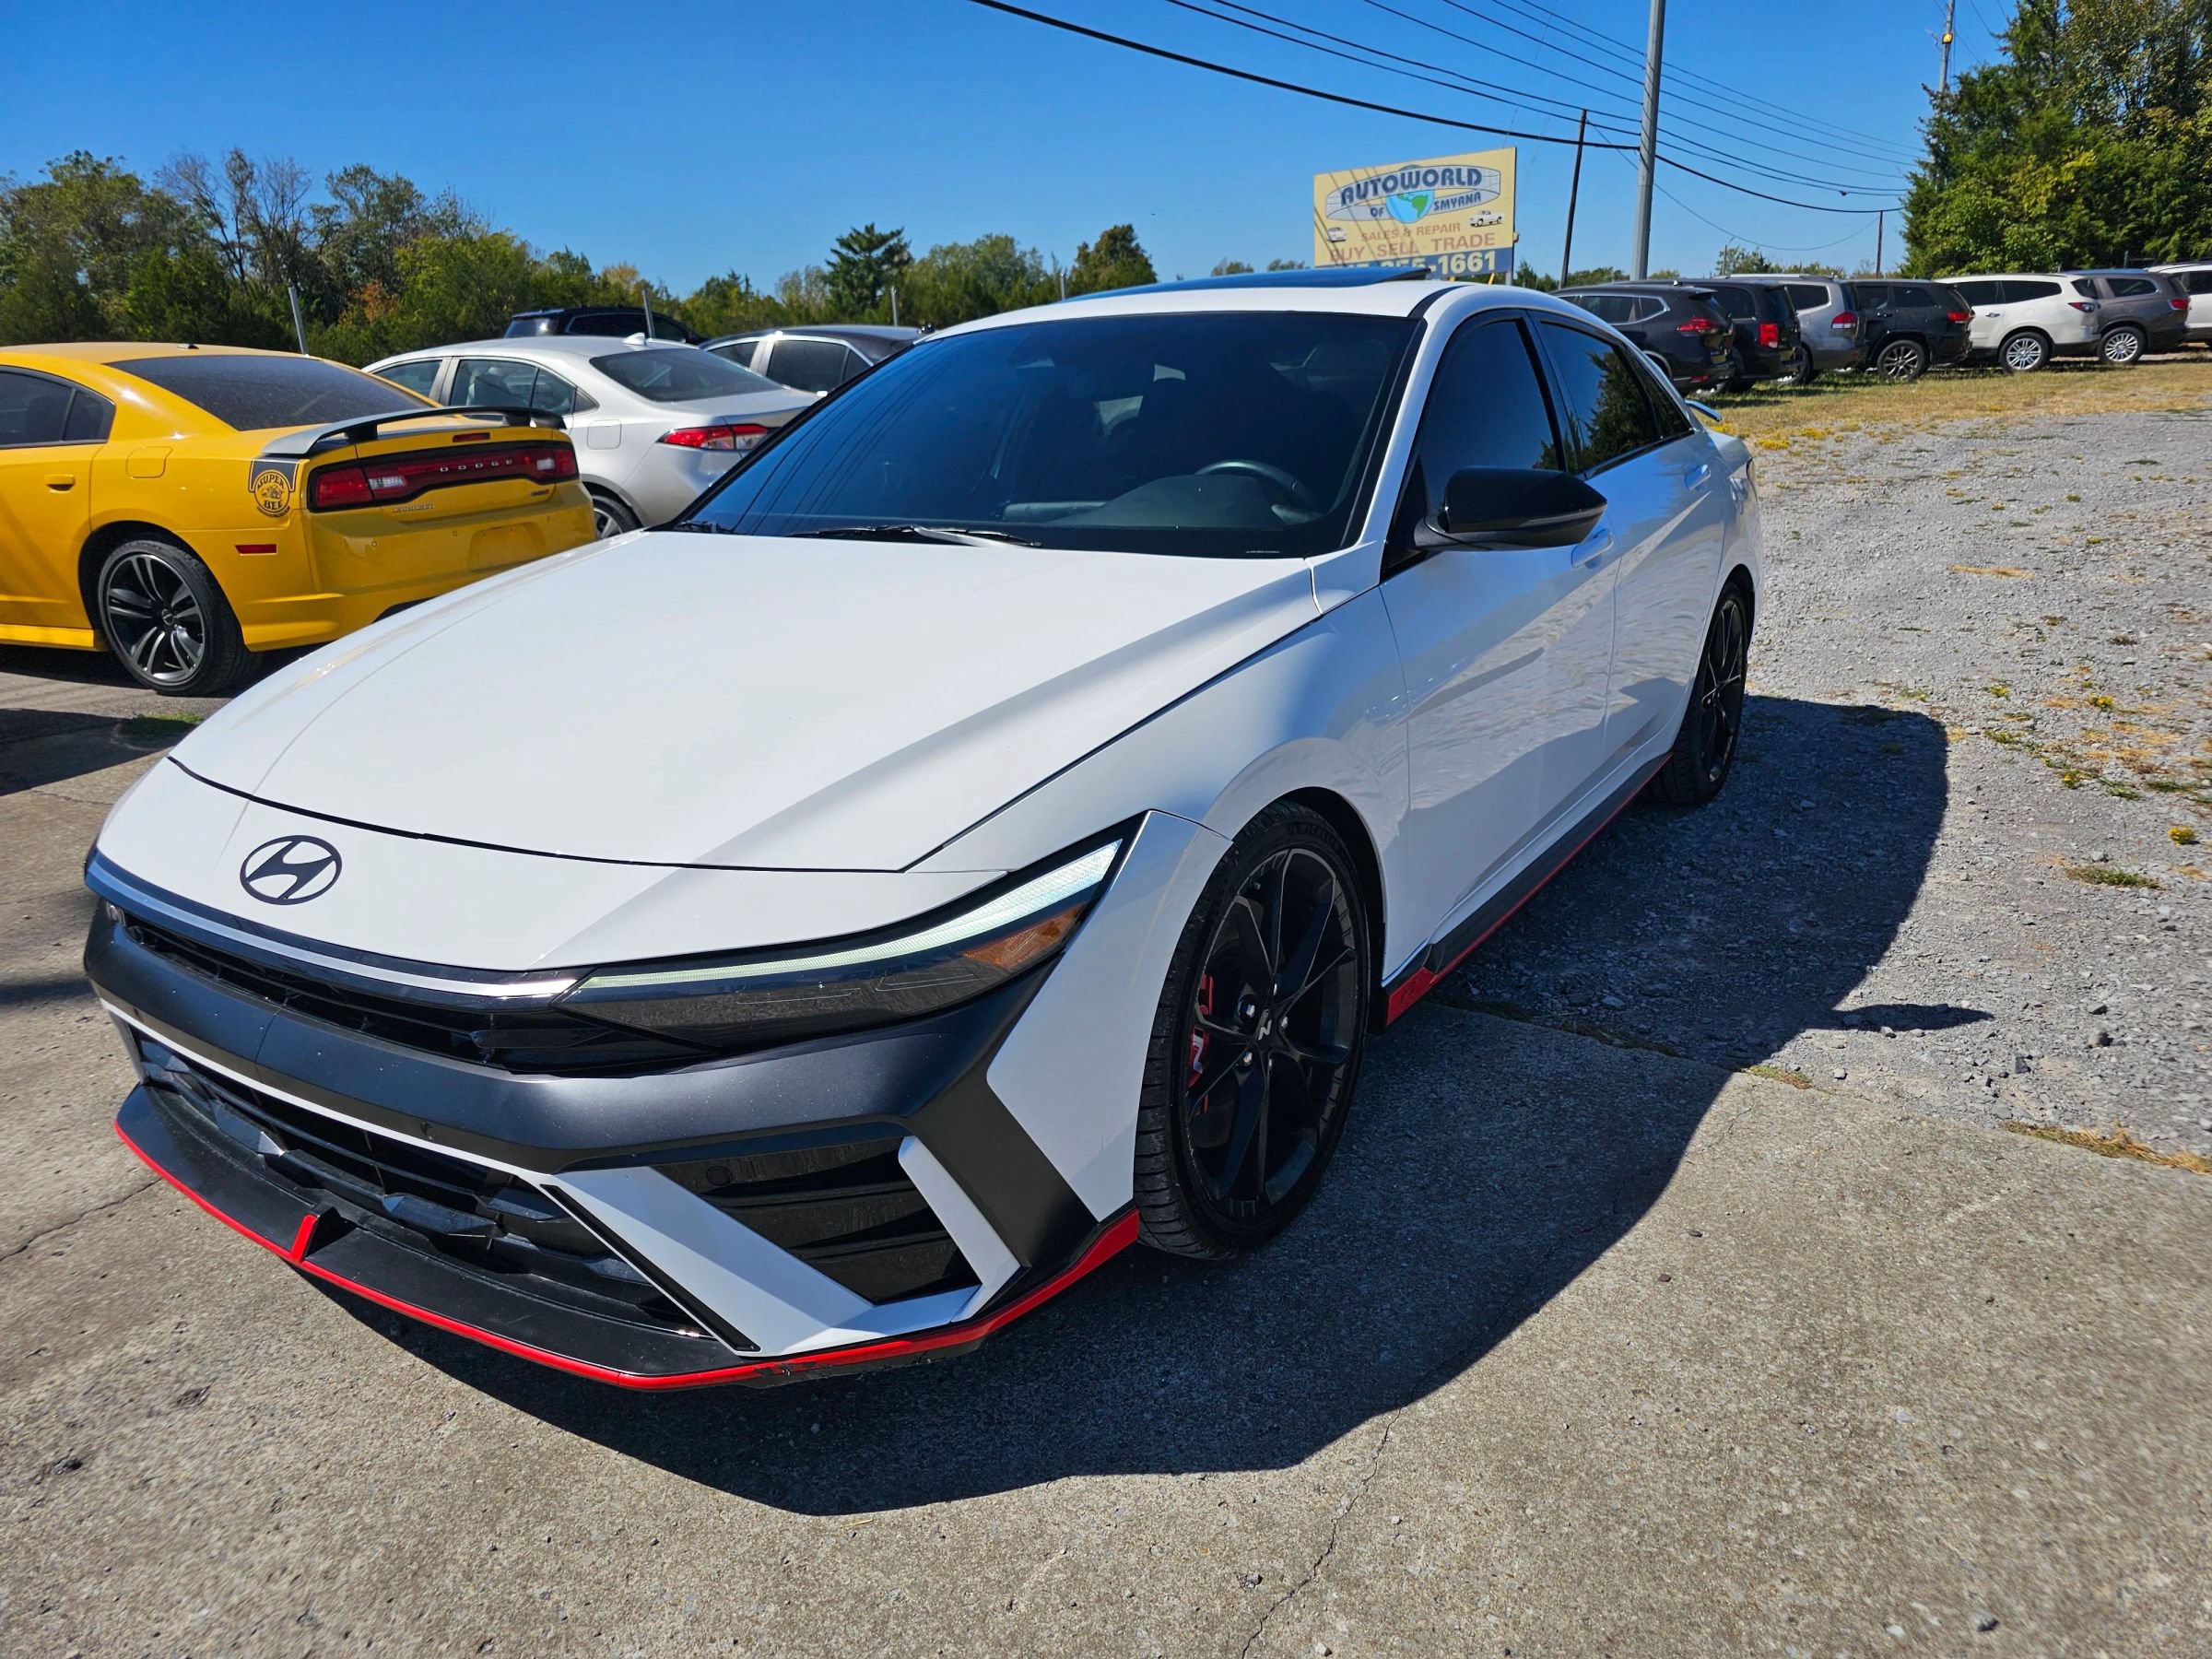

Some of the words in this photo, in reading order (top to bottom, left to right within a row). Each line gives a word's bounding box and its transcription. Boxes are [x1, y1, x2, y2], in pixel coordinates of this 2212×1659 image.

[1341, 168, 1482, 206] AUTOWORLD
[1371, 206, 1384, 218] OF
[1433, 192, 1481, 212] SMYRNA
[1361, 229, 1399, 242] SALES
[1403, 227, 1411, 237] &
[1417, 222, 1461, 237] REPAIR
[1330, 245, 1364, 262] BUY
[1377, 241, 1419, 257] SELL
[1430, 232, 1495, 252] TRADE
[440, 459, 513, 473] DODGE
[257, 474, 285, 489] SUPER
[264, 500, 283, 511] BEE
